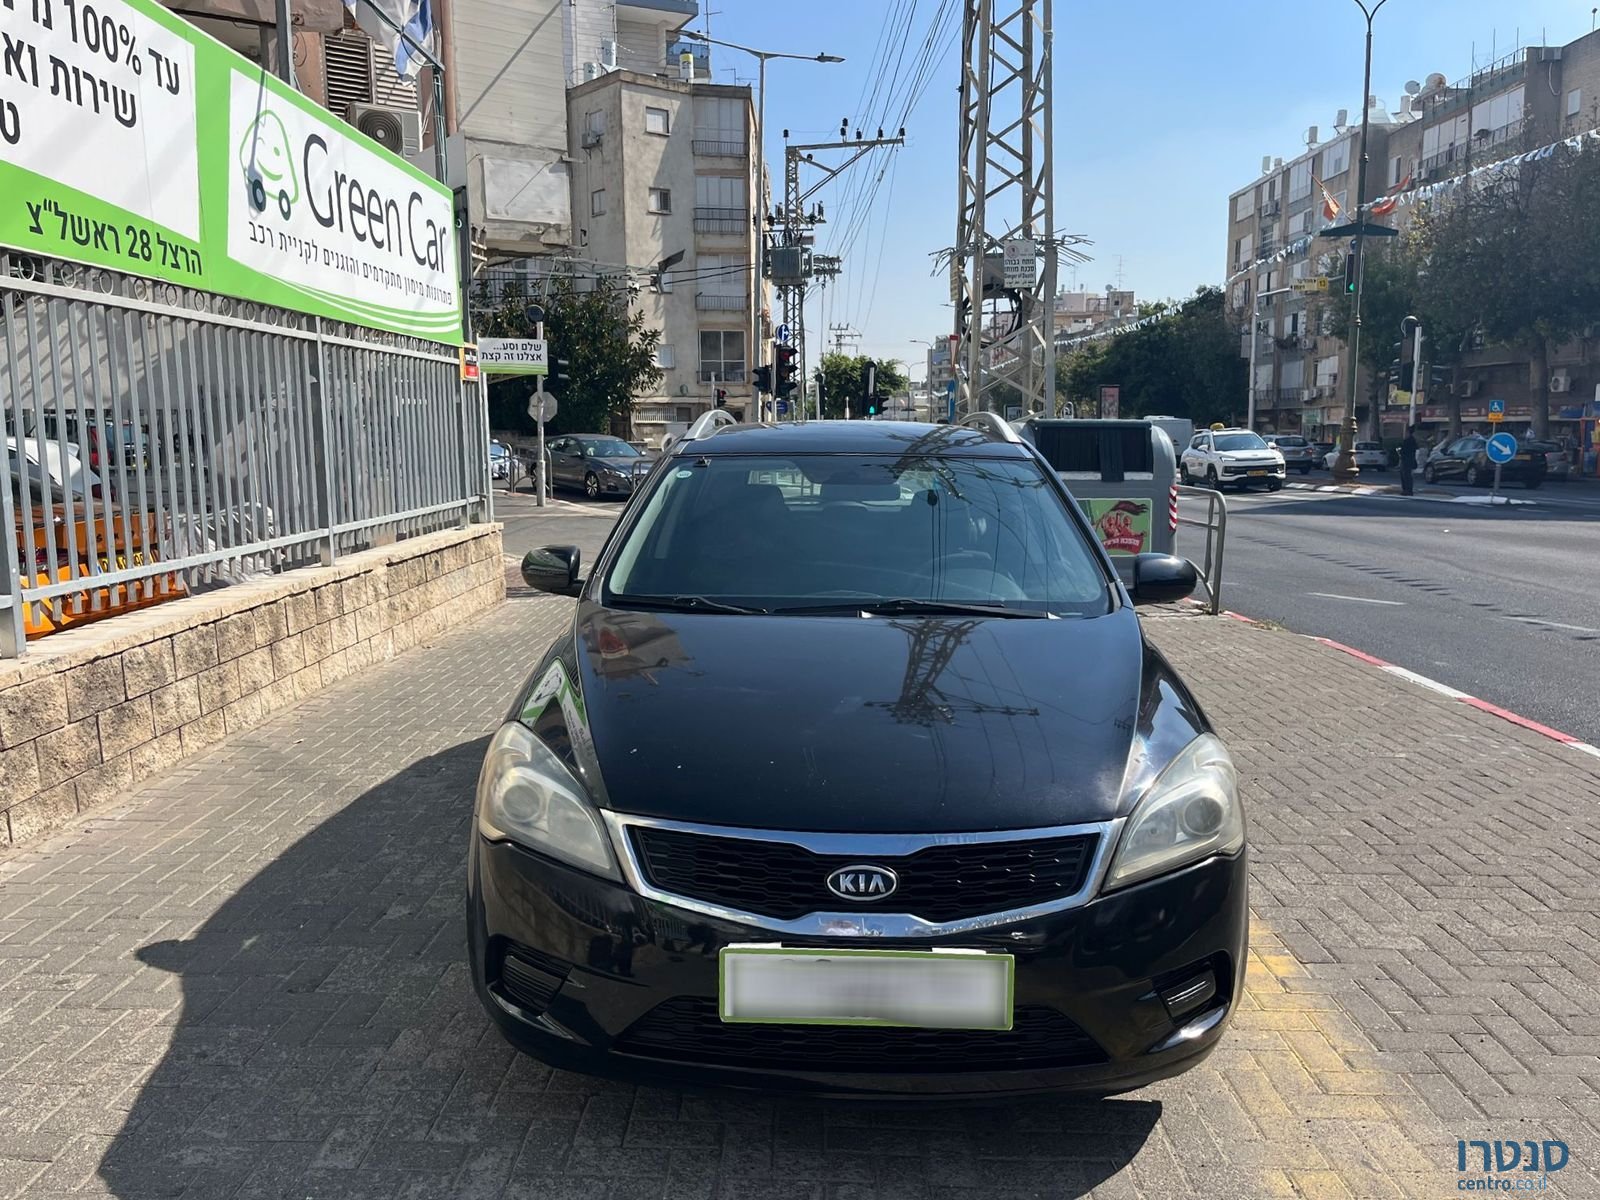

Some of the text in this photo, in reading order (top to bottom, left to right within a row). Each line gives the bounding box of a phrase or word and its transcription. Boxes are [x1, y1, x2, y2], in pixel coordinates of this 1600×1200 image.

[63, 0, 142, 76] 100%
[49, 54, 137, 128] שירות
[148, 47, 180, 95] עד
[303, 133, 447, 273] Green Car
[125, 225, 152, 262] 28
[157, 232, 202, 276] הרצל
[248, 221, 452, 305] פתרונות מימון מתקדמים והוגנים לקניית רכב
[481, 352, 542, 362] אצלנו זה קצת
[521, 342, 542, 351] שלם
[839, 873, 886, 893] KIA
